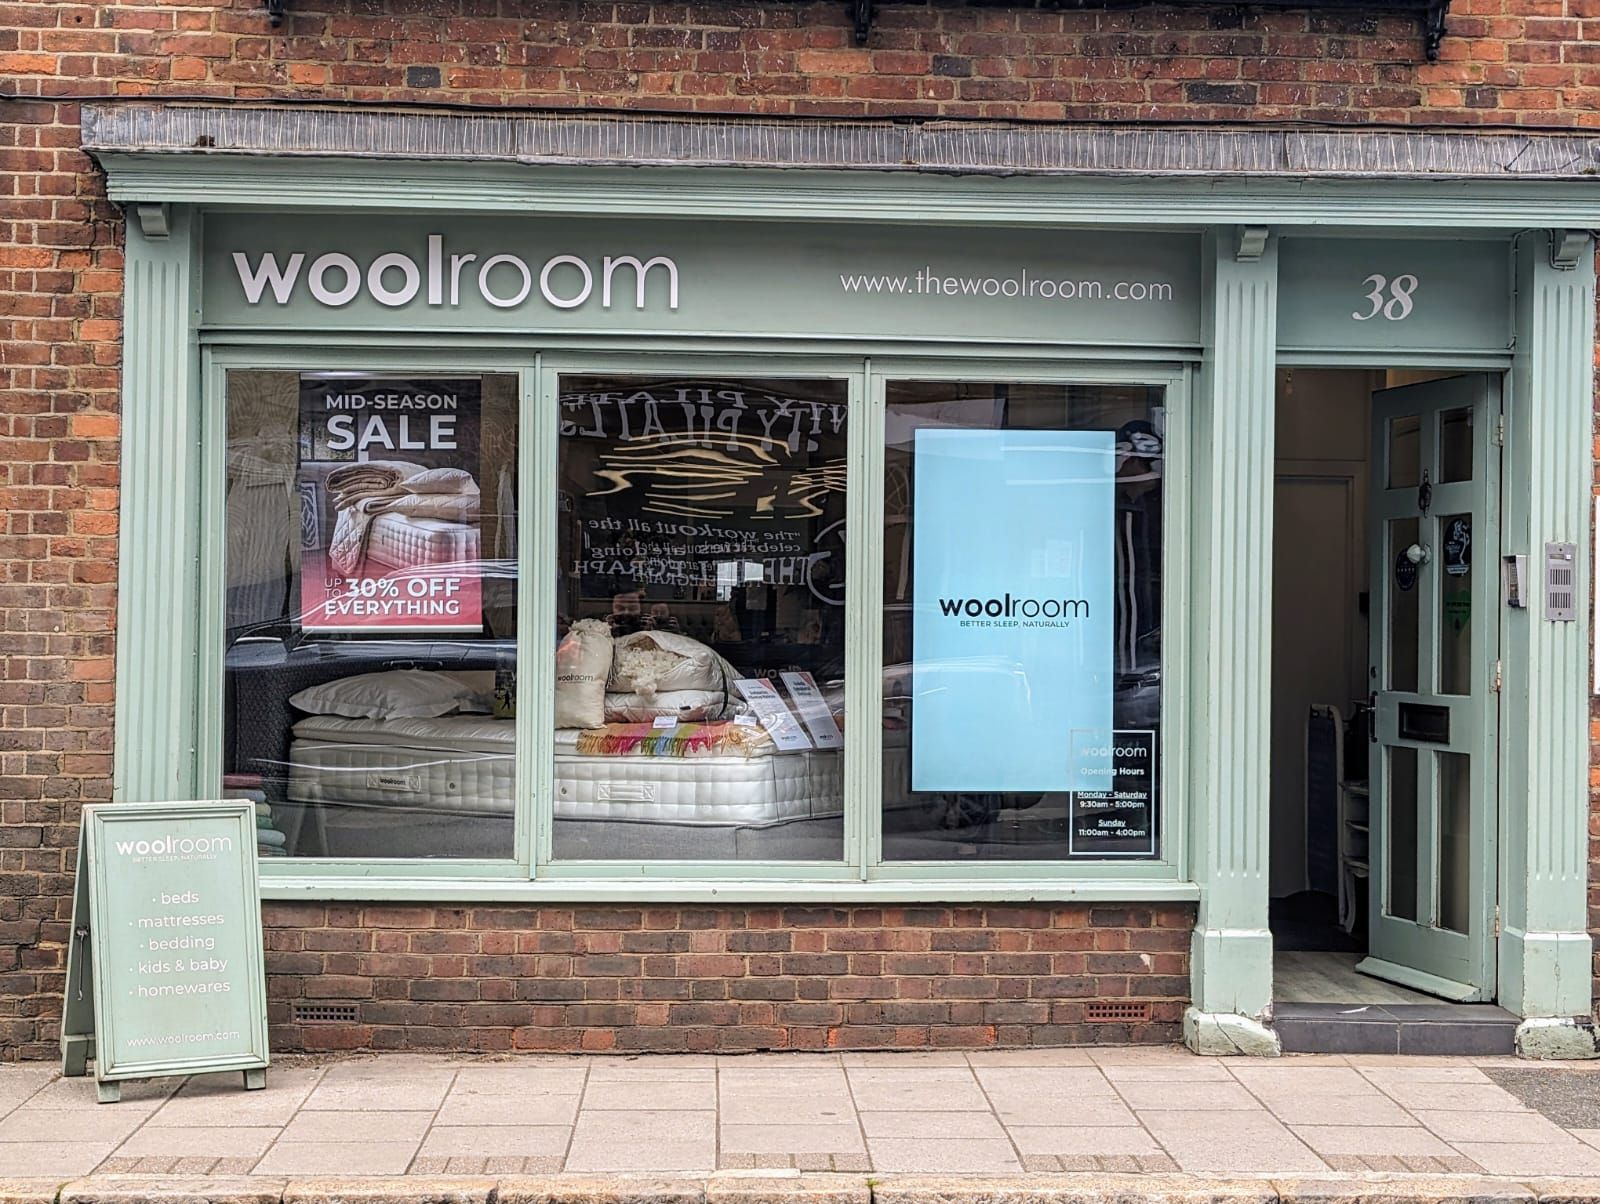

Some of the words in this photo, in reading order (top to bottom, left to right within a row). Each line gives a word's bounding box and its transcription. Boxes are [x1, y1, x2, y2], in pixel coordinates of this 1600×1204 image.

[232, 234, 678, 309] woolroom
[840, 266, 1173, 301] www.thewoolroom.com
[1352, 273, 1419, 321] 38
[326, 394, 458, 410] MID-SEASON
[327, 414, 457, 451] SALE
[324, 577, 342, 588] UP
[345, 578, 399, 598] 30%
[407, 578, 460, 597] OFF
[325, 588, 342, 598] TO
[325, 599, 460, 615] EVERYTHING
[939, 593, 1089, 618] woolroom
[960, 620, 991, 628] BETTER
[993, 620, 1021, 629] SLEEP,
[1023, 620, 1069, 628] NATURALLY
[1080, 767, 1117, 777] Opening
[1119, 767, 1145, 776] Hours
[1077, 791, 1107, 799] Monday
[1114, 791, 1147, 800] Saturday
[1115, 801, 1145, 809] 5:00pm
[1098, 819, 1126, 827] Sunday
[1116, 829, 1145, 837] 4:00pm
[116, 835, 232, 856] woolroom
[161, 891, 200, 905] beds
[138, 913, 225, 928] mattresses
[149, 936, 215, 951] bedding
[138, 960, 171, 974] kids
[175, 959, 185, 972] &
[190, 957, 228, 972] baby
[138, 981, 231, 997] homewares
[126, 1030, 240, 1047] www.woolroom.com
